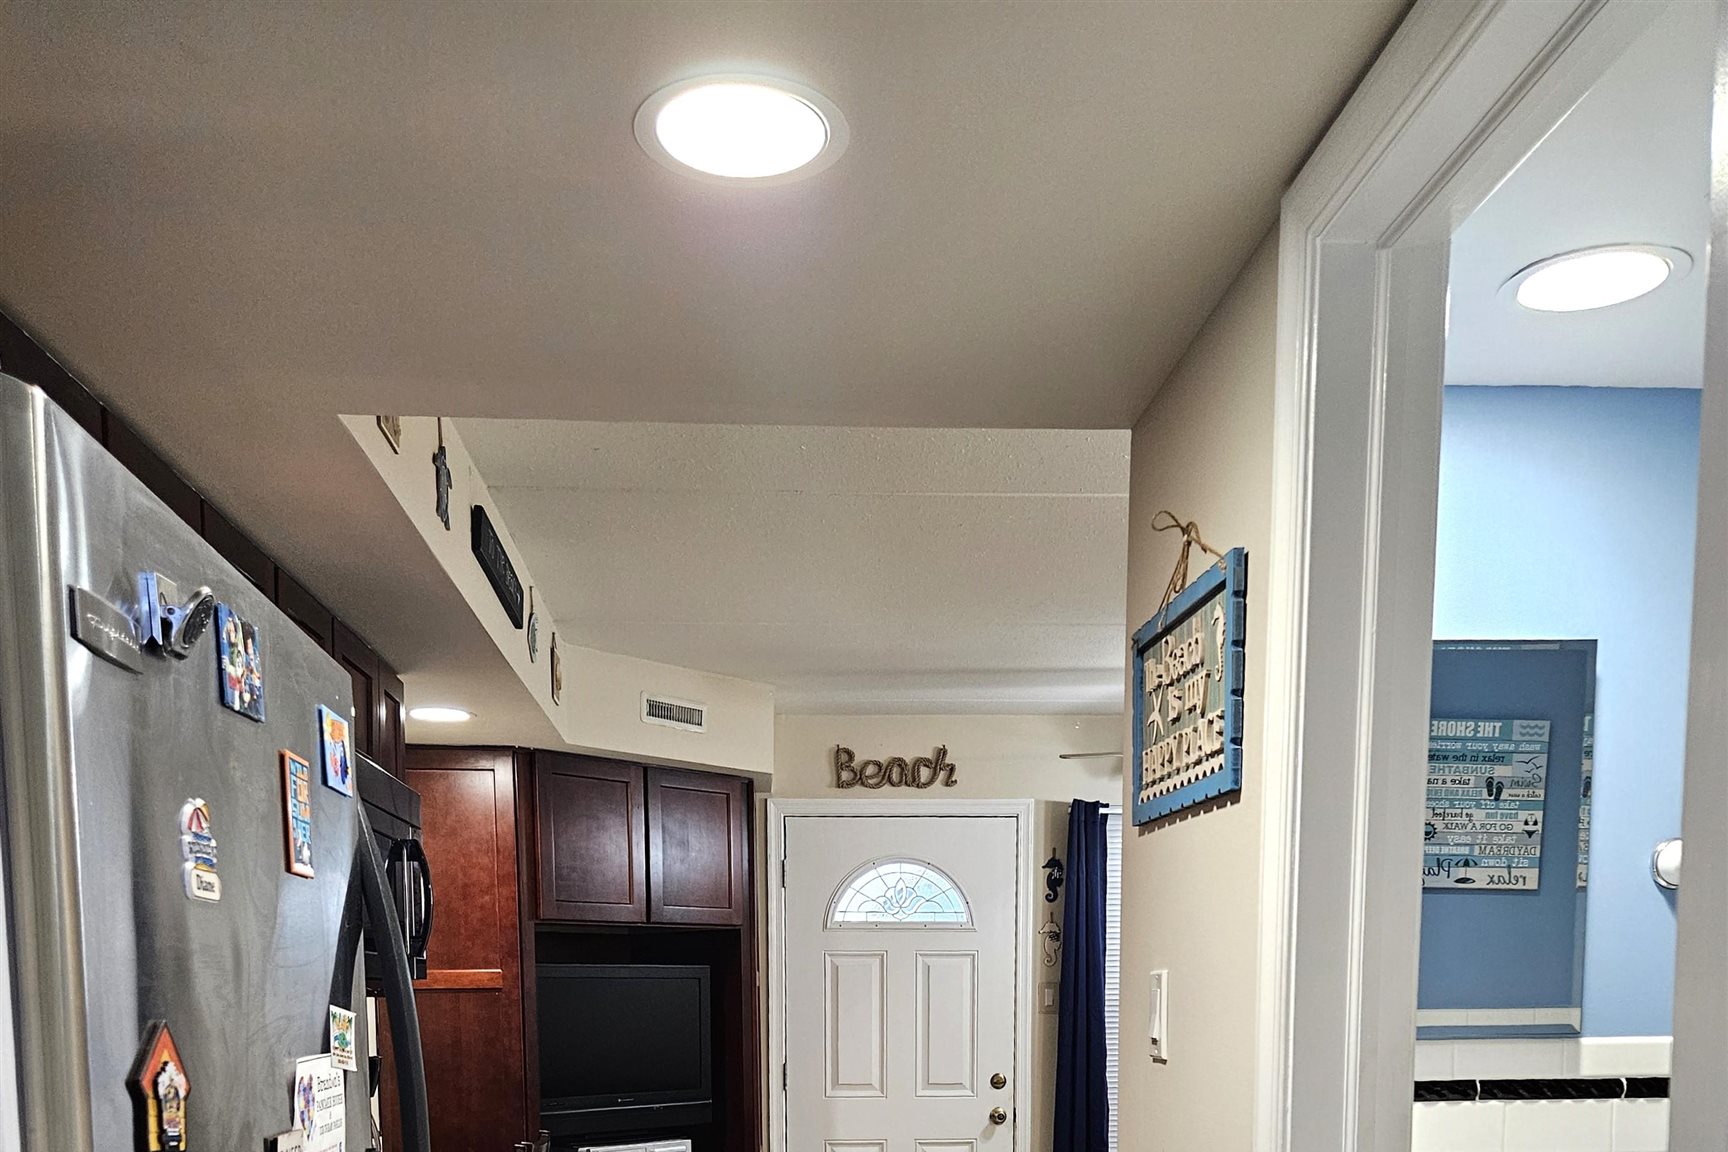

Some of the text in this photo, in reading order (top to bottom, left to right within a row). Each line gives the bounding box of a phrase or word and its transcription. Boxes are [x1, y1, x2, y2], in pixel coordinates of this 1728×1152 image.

[1144, 616, 1206, 693] The Beach
[834, 746, 958, 789] Beach
[1142, 709, 1225, 785] HAPPY PLACE
